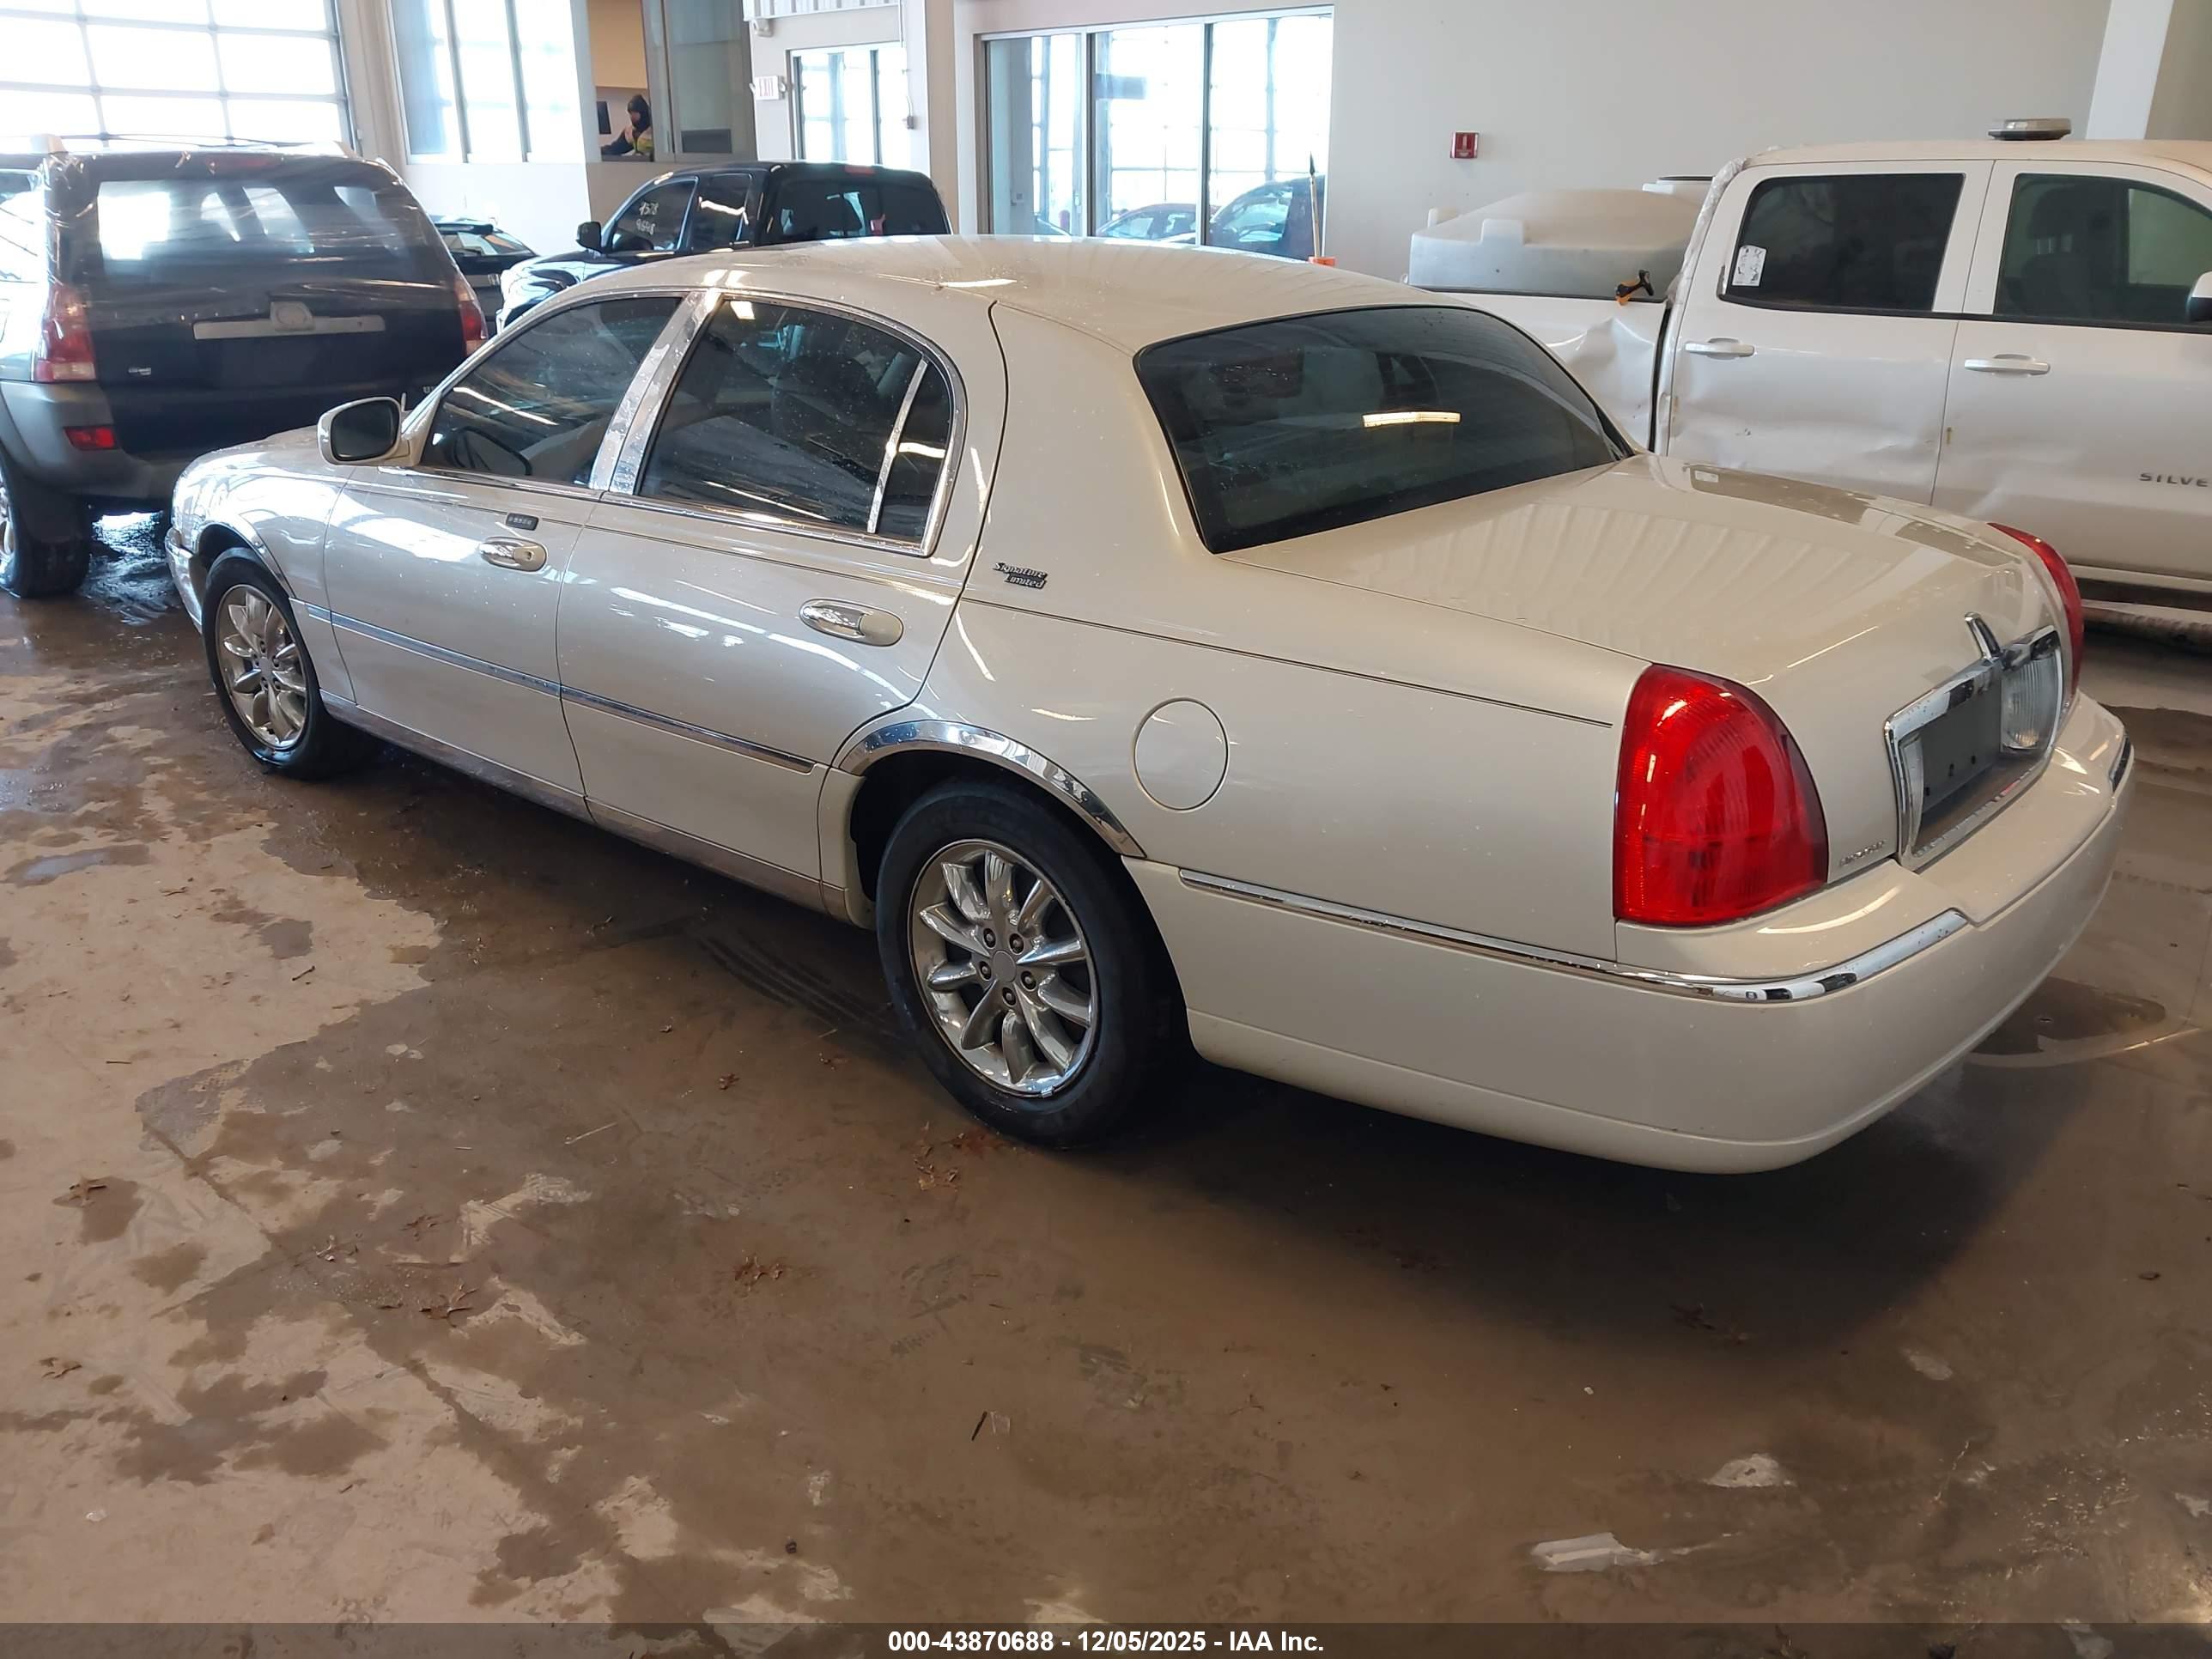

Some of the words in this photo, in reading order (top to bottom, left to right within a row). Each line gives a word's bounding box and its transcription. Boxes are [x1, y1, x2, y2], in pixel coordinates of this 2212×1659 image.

[758, 77, 775, 97] EXIT
[2139, 473, 2209, 488] SILVE
[994, 562, 1046, 578] Signature
[1003, 574, 1046, 588] Limited
